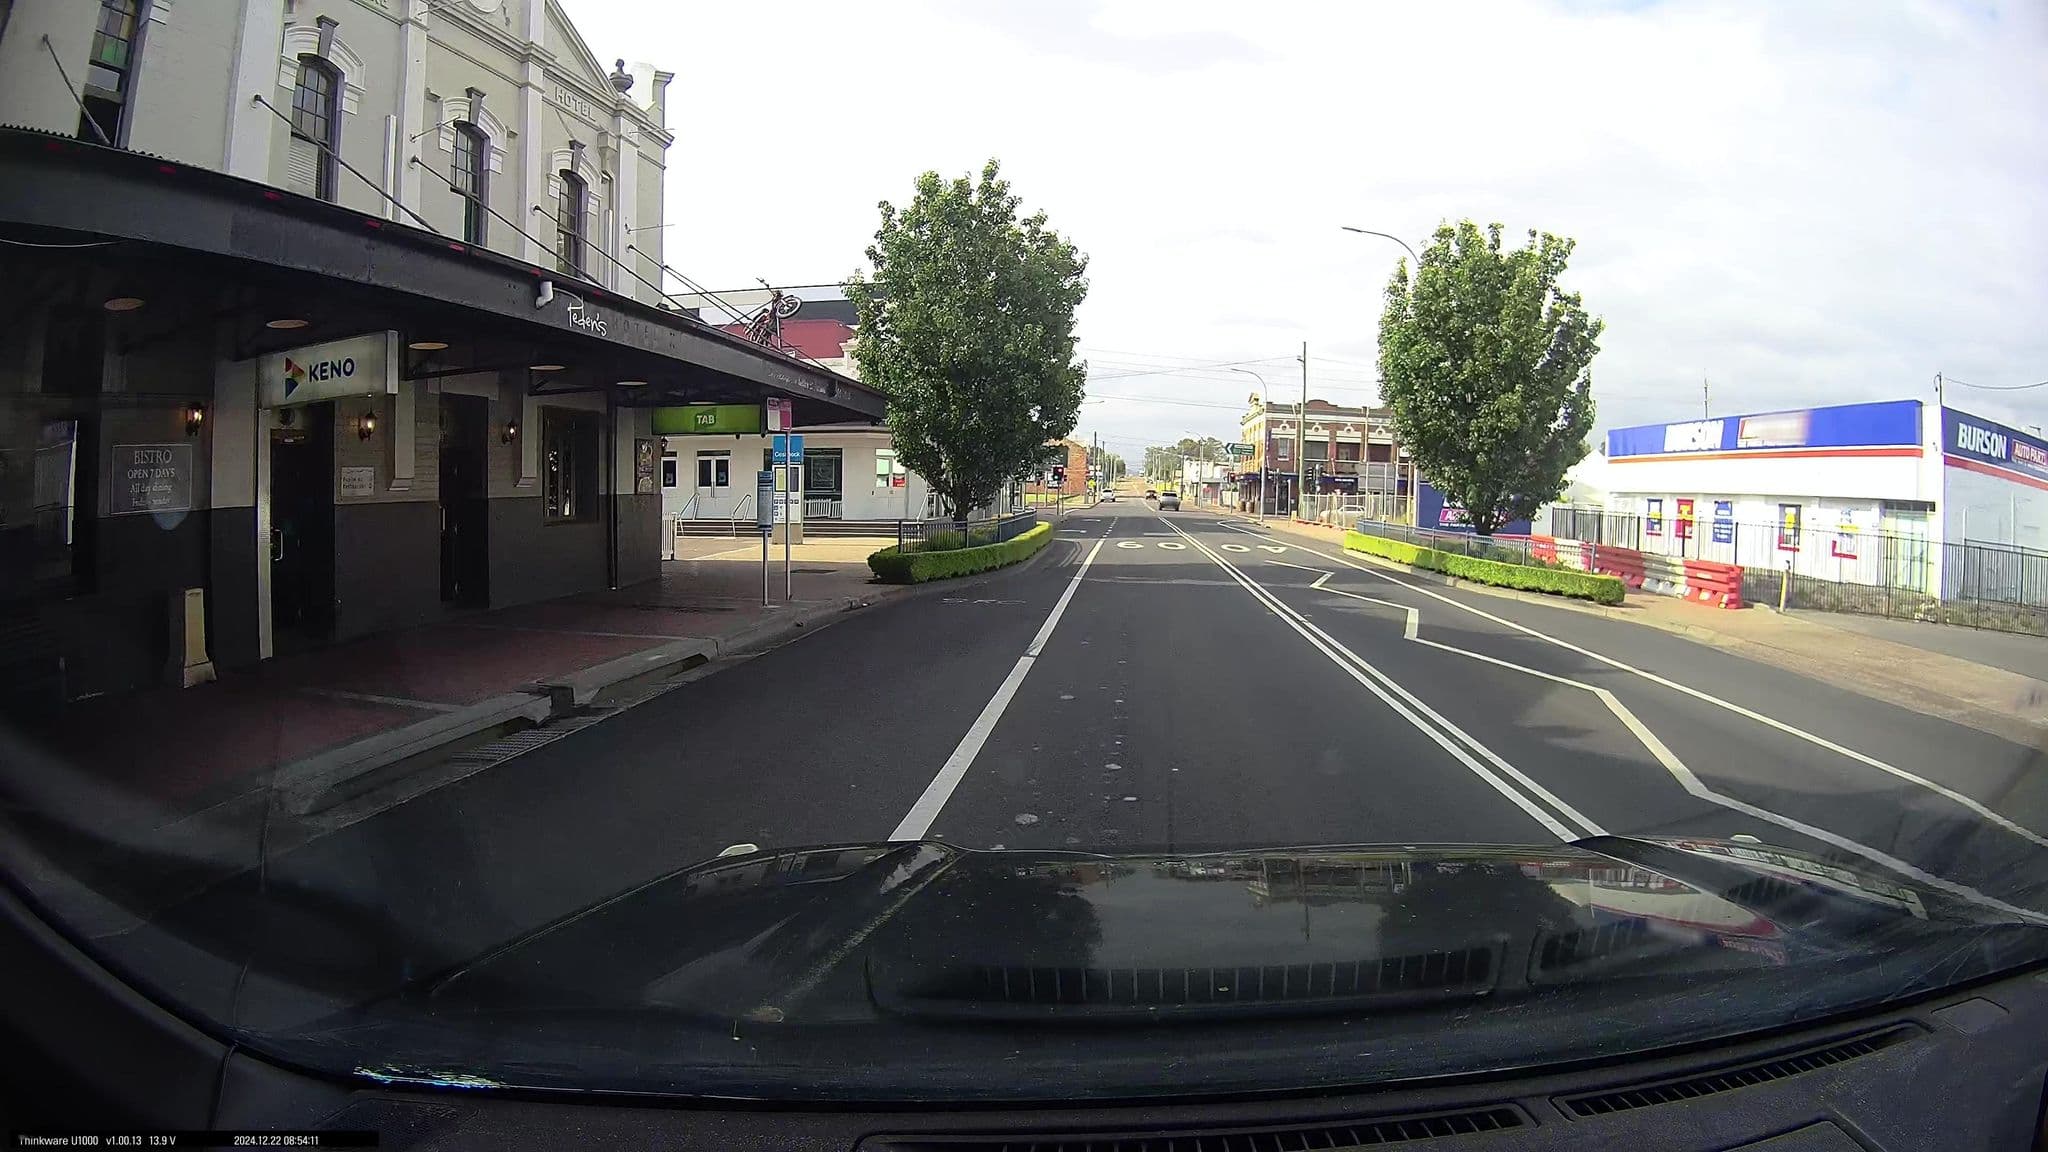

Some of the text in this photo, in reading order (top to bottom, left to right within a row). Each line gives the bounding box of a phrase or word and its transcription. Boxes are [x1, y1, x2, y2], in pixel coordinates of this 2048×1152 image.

[554, 86, 596, 122] HOTEL
[567, 294, 607, 337] Peden's
[309, 358, 355, 382] KENO
[696, 415, 715, 425] TAB
[1957, 422, 2007, 459] BURSON
[134, 449, 172, 464] BISTRO
[2015, 443, 2030, 459] AUTO
[127, 467, 176, 479] OPEN 7 DAYS
[130, 483, 140, 493] All
[1116, 541, 1186, 550] 60
